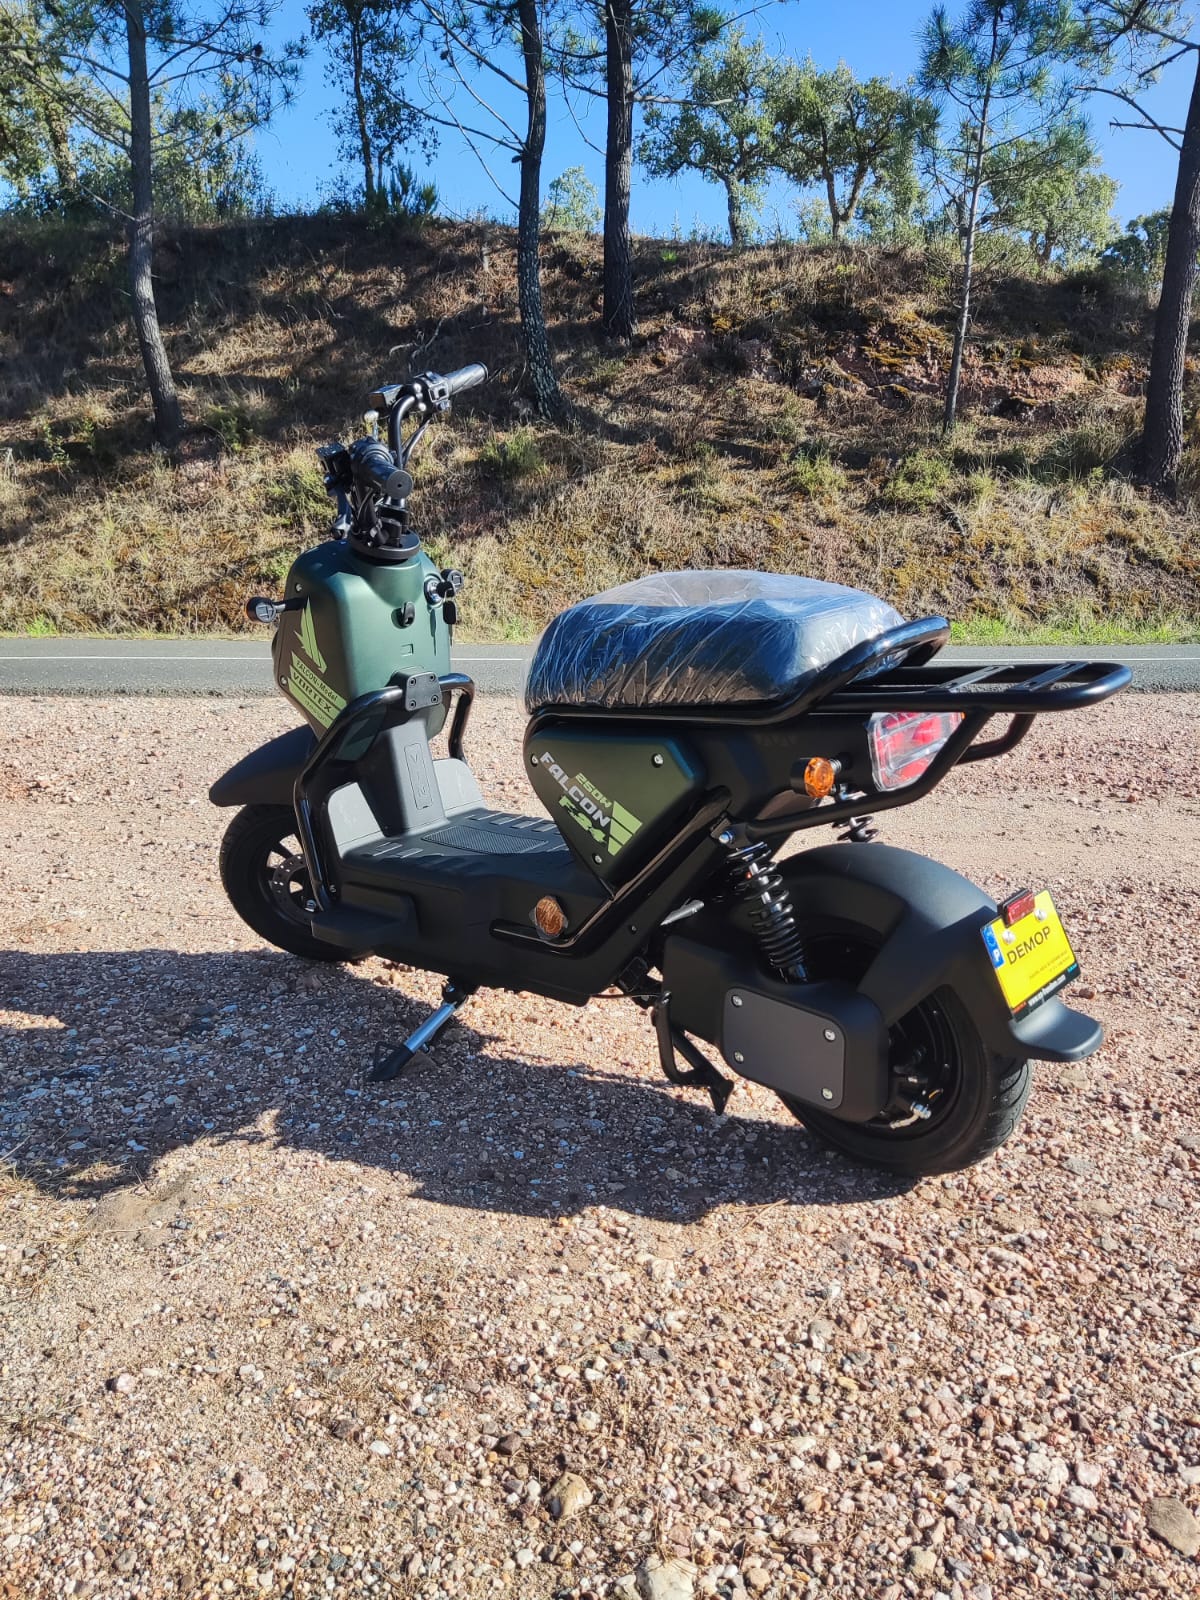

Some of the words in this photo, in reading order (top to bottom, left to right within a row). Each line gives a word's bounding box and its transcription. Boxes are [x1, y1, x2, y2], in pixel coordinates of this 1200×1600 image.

[293, 672, 331, 712] VORTEX
[540, 752, 610, 826] FALCON
[575, 772, 612, 808] 250W
[993, 949, 1001, 961] P
[1007, 927, 1050, 964] DEMOP
